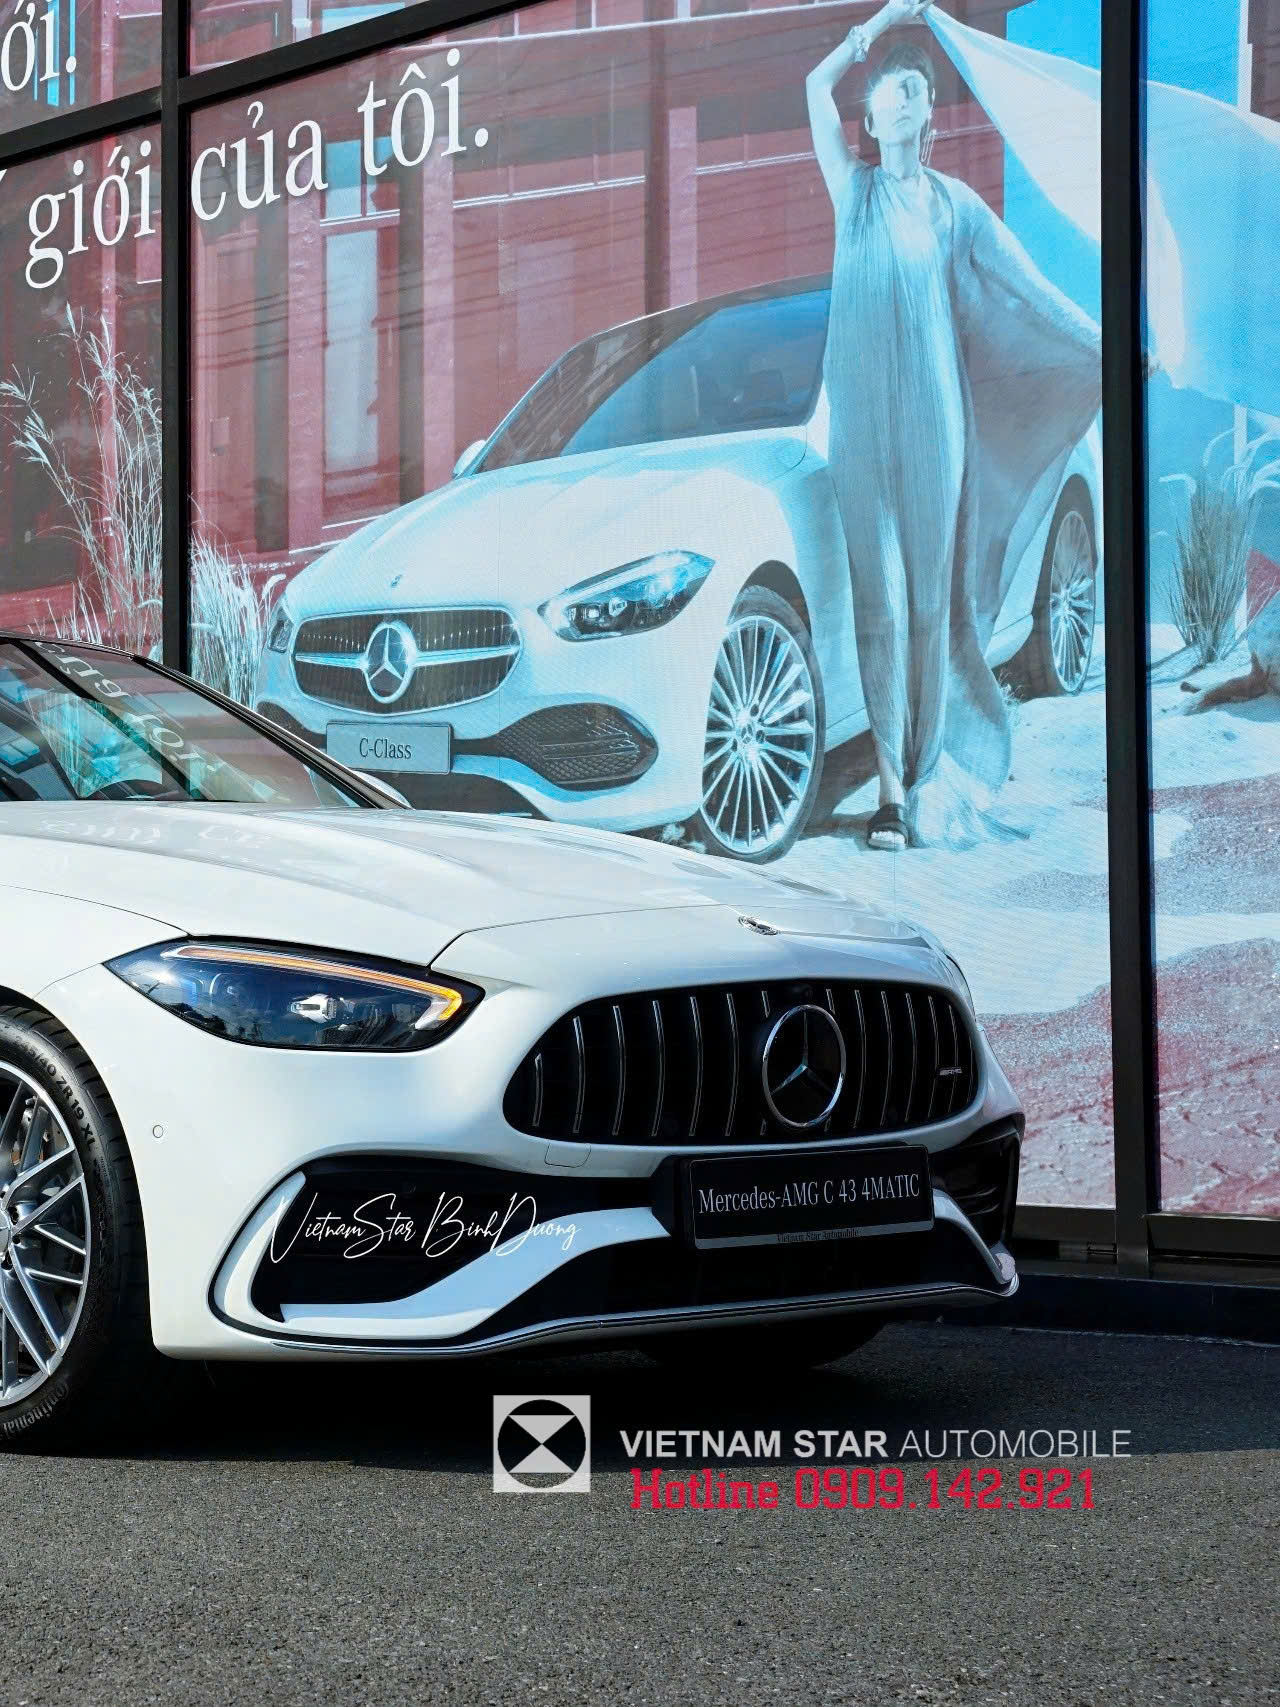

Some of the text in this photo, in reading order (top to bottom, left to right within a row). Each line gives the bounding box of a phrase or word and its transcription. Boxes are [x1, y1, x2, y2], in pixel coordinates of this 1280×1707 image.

[24, 140, 157, 289] giới
[190, 100, 328, 222] của
[357, 47, 489, 178] tôi.
[359, 737, 412, 759] C-Class
[698, 1173, 920, 1214] Mercedes-AMG C 43 4MATIC
